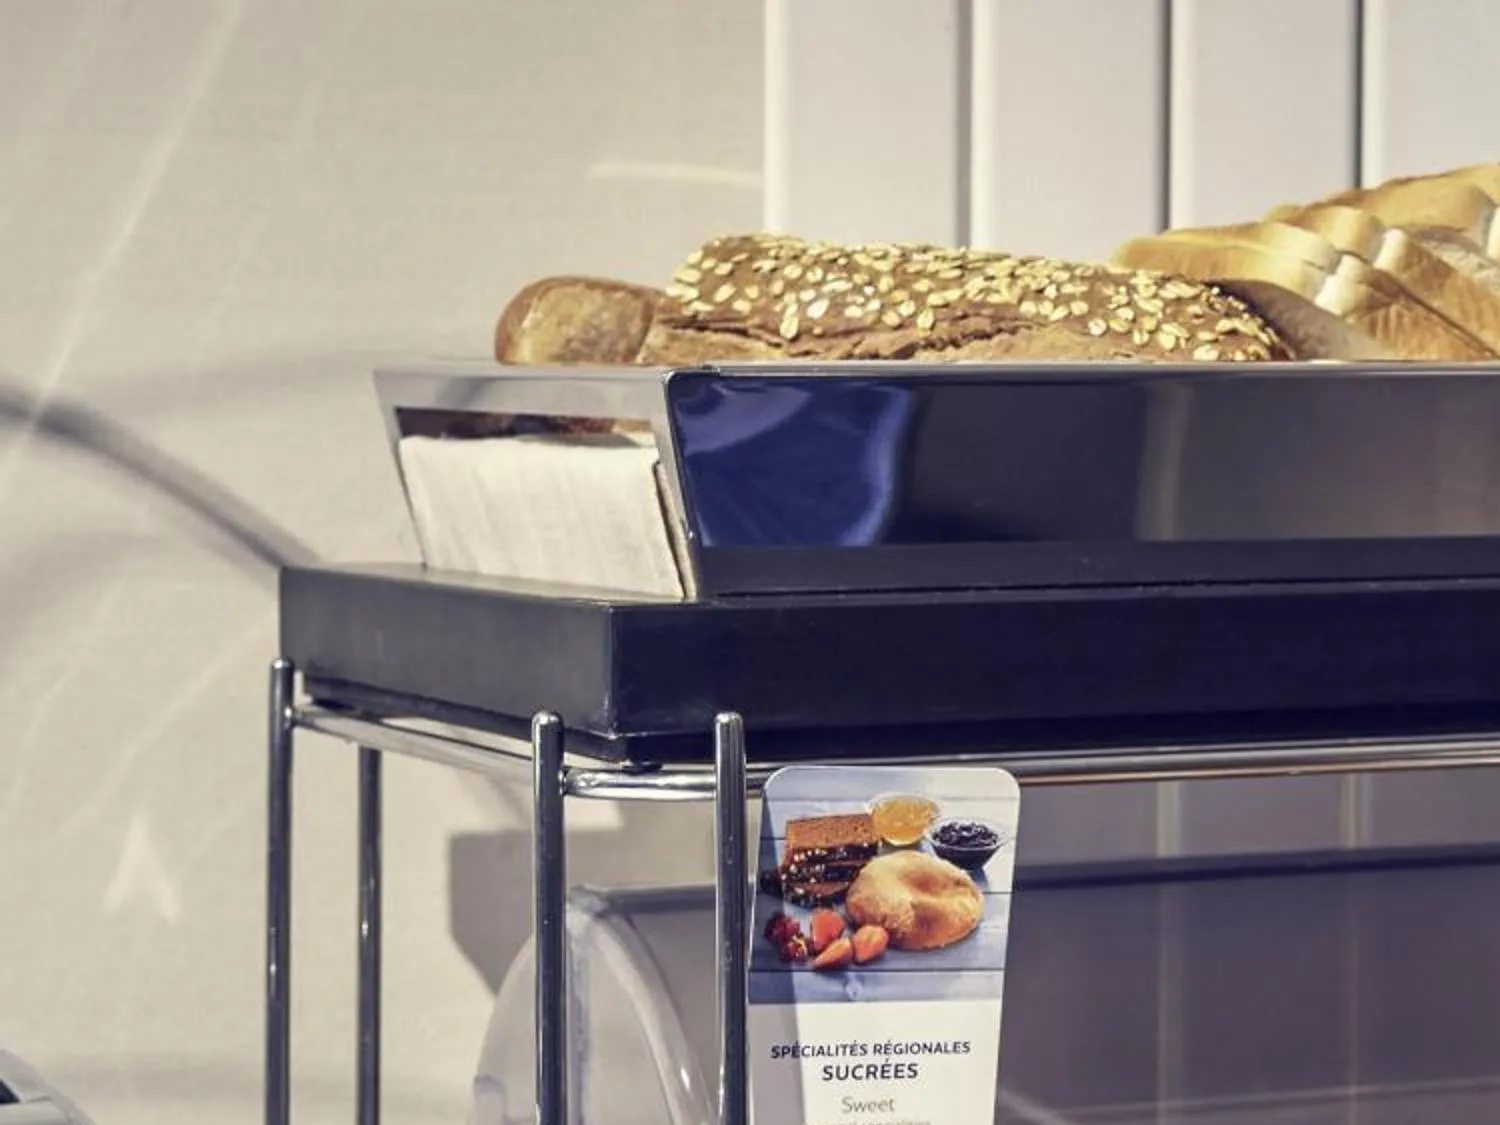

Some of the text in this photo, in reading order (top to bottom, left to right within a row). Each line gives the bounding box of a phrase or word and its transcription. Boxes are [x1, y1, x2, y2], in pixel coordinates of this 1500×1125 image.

[771, 1040, 971, 1059] SPÉCIALITÉS RÉGIONALES
[822, 1060, 919, 1080] SUCRÉES
[840, 1096, 896, 1115] Sweet
